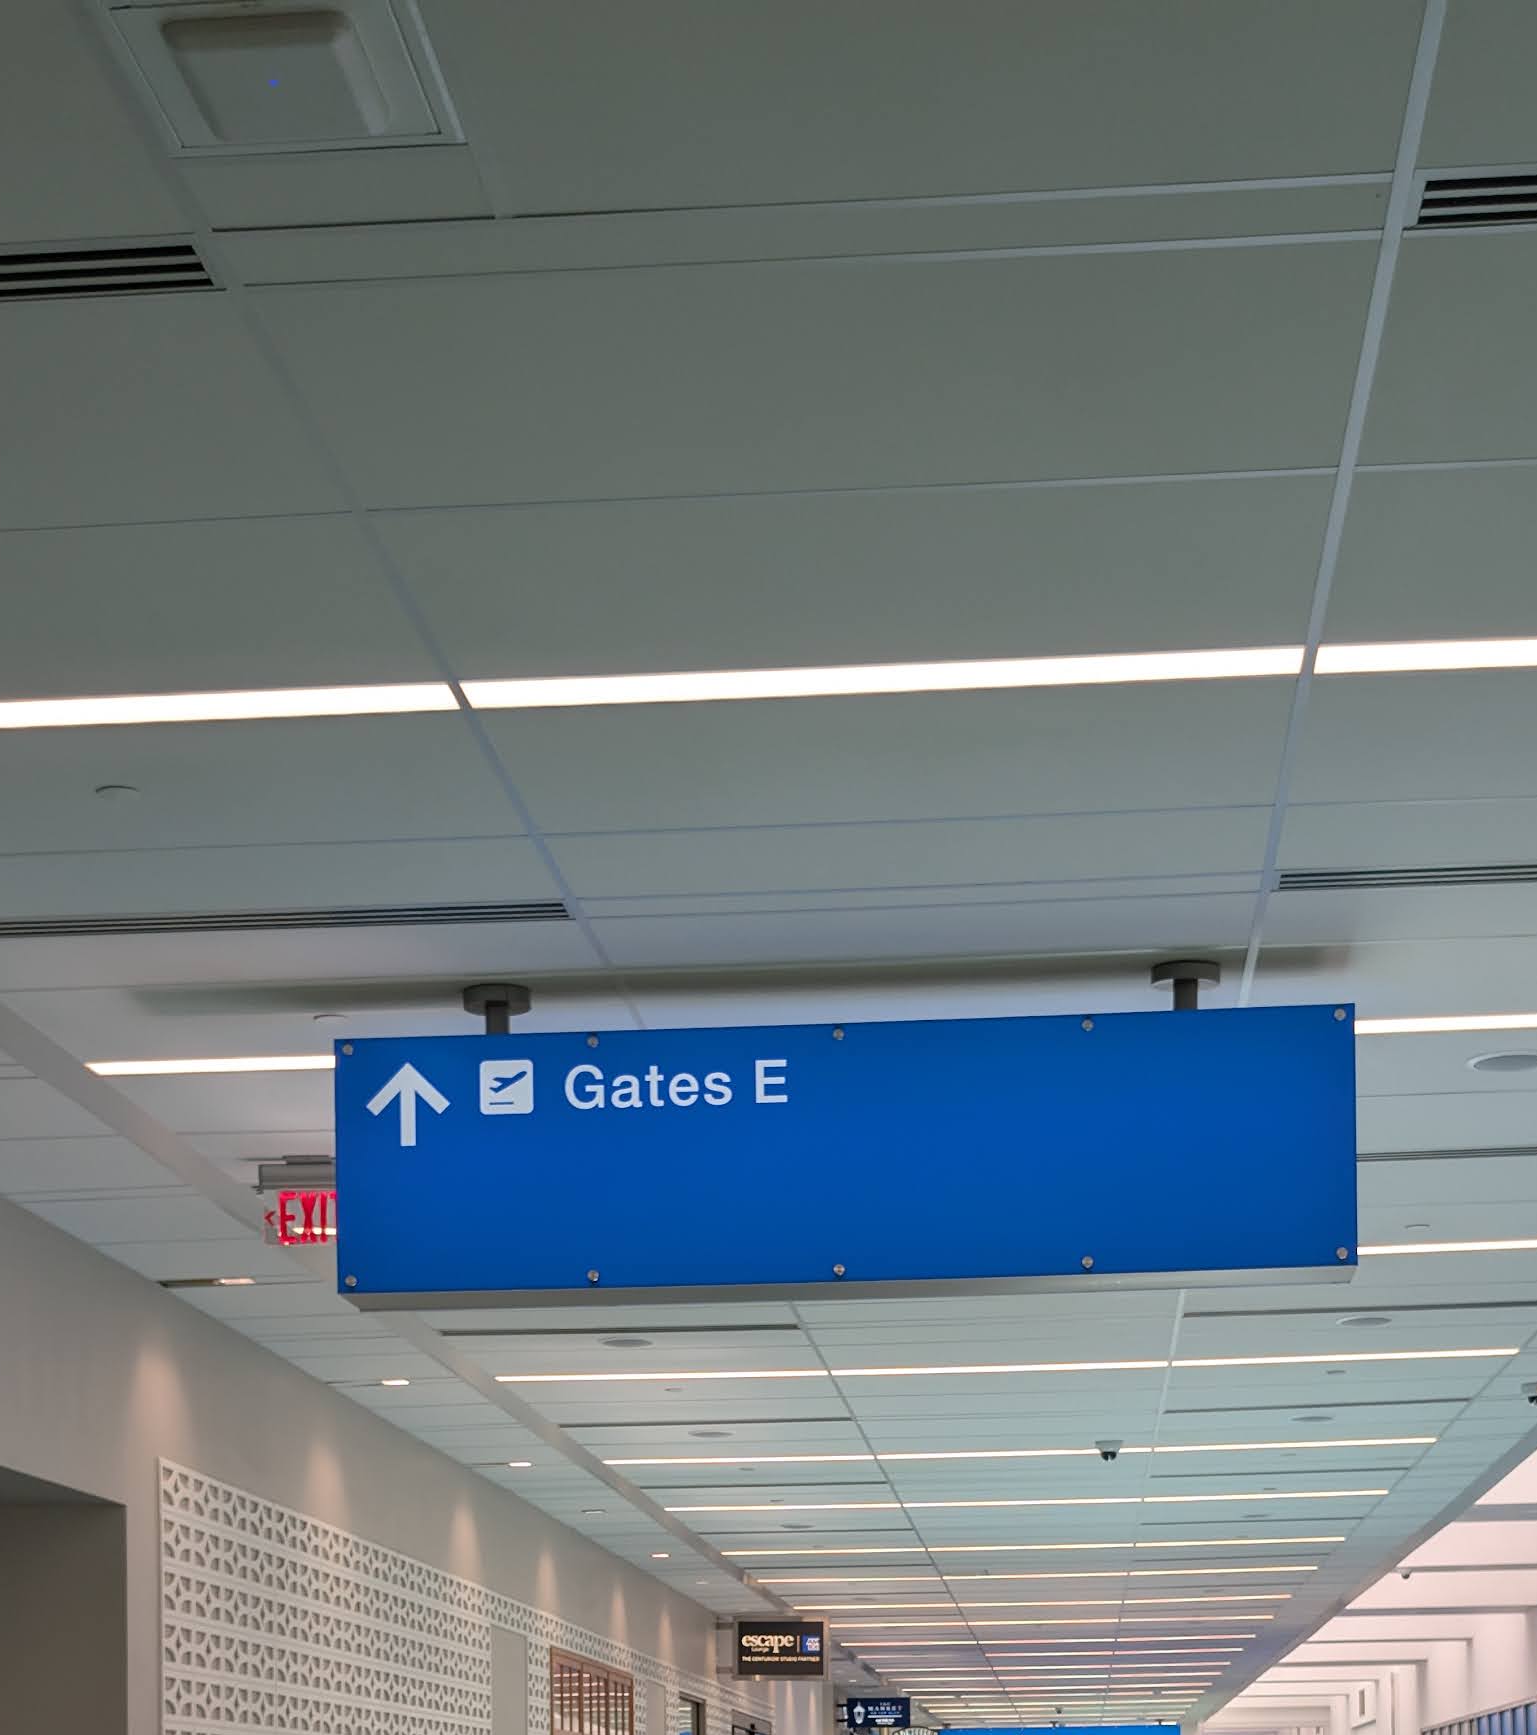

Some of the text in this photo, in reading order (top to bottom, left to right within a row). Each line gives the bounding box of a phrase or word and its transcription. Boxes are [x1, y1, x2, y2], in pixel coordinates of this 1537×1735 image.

[564, 1059, 788, 1110] Gates E
[741, 1634, 795, 1654] escape
